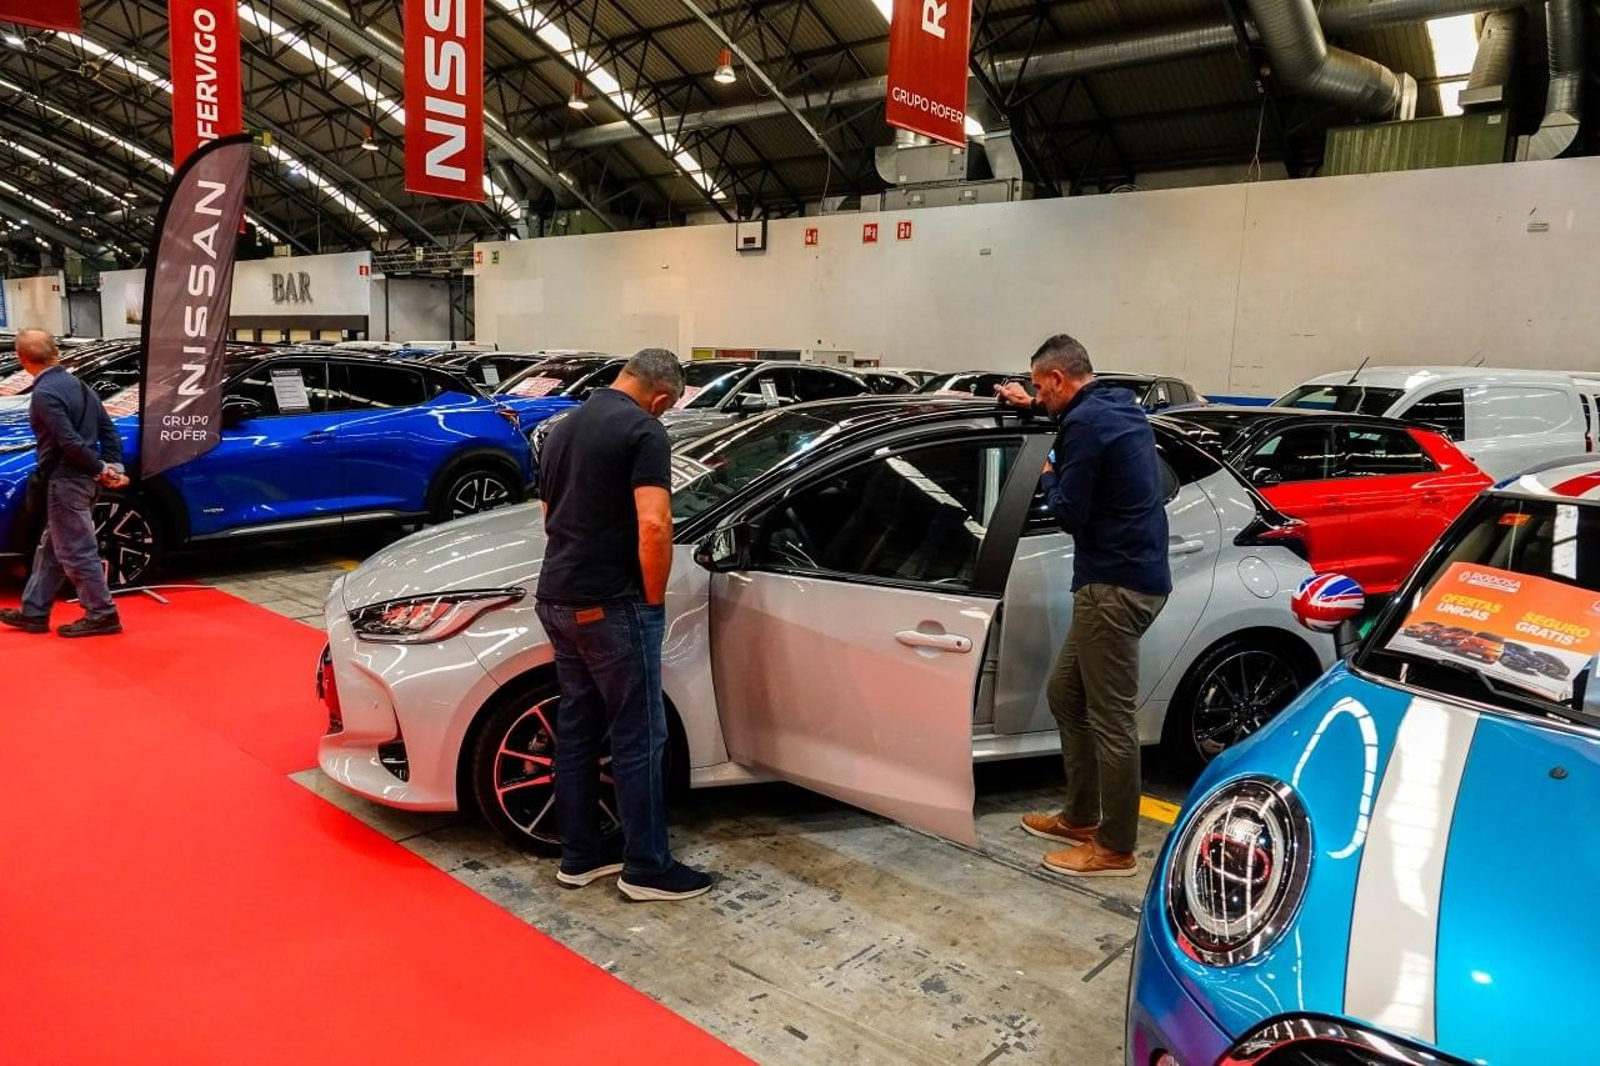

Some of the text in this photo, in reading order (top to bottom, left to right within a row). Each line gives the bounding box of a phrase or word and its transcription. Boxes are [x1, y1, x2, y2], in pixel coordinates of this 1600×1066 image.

[193, 8, 219, 149] FERVIGO
[891, 86, 964, 124] GRUPO ROFER
[176, 180, 226, 397] NISSAN
[271, 271, 313, 304] BAR
[160, 430, 207, 441] ROFER
[162, 415, 209, 426] GRUPO
[1441, 593, 1503, 613] OFERTAS
[1522, 611, 1591, 638] SEGURO
